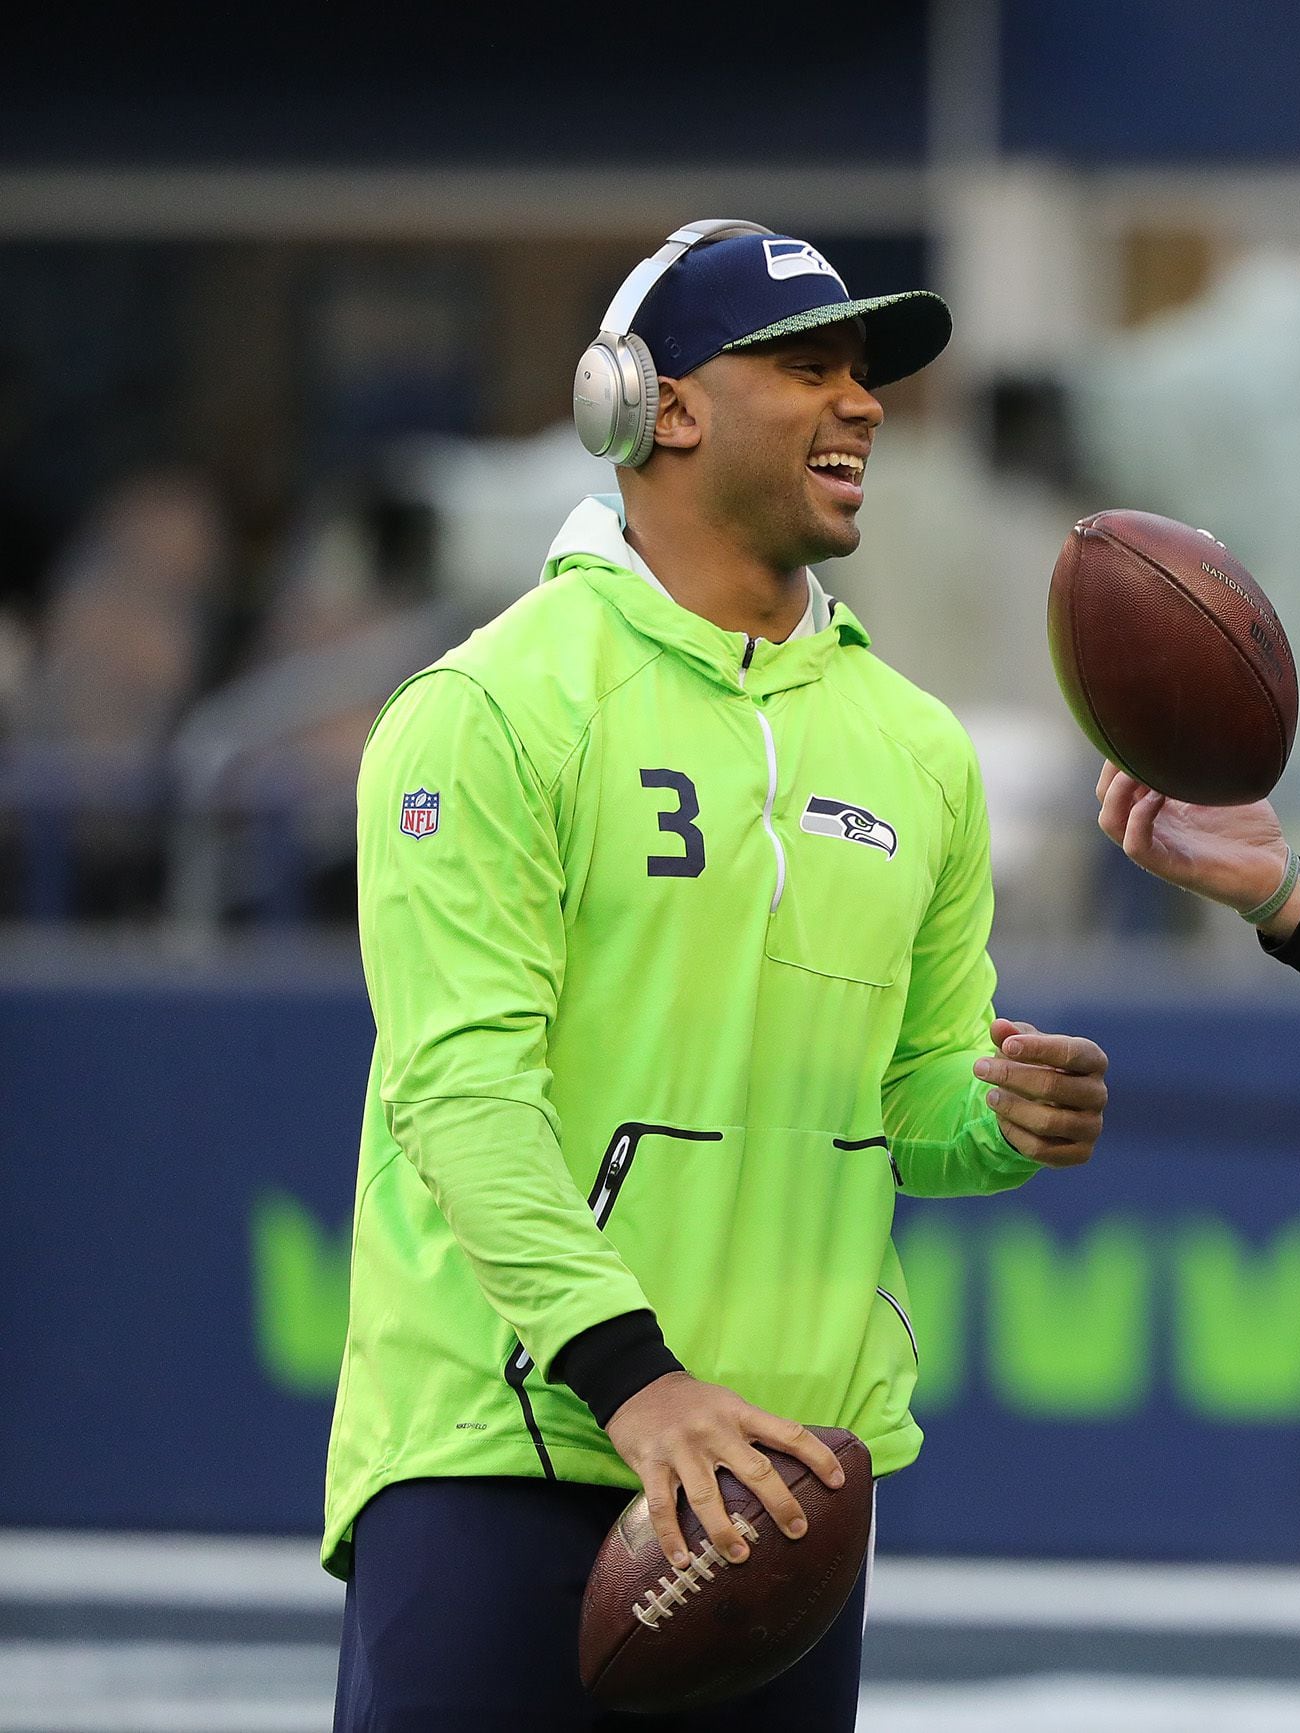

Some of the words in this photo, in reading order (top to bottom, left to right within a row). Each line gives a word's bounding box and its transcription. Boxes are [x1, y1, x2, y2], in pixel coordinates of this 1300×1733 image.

[1201, 561, 1256, 608] NATIONAL
[402, 808, 436, 833] NFL
[638, 768, 708, 878] 3
